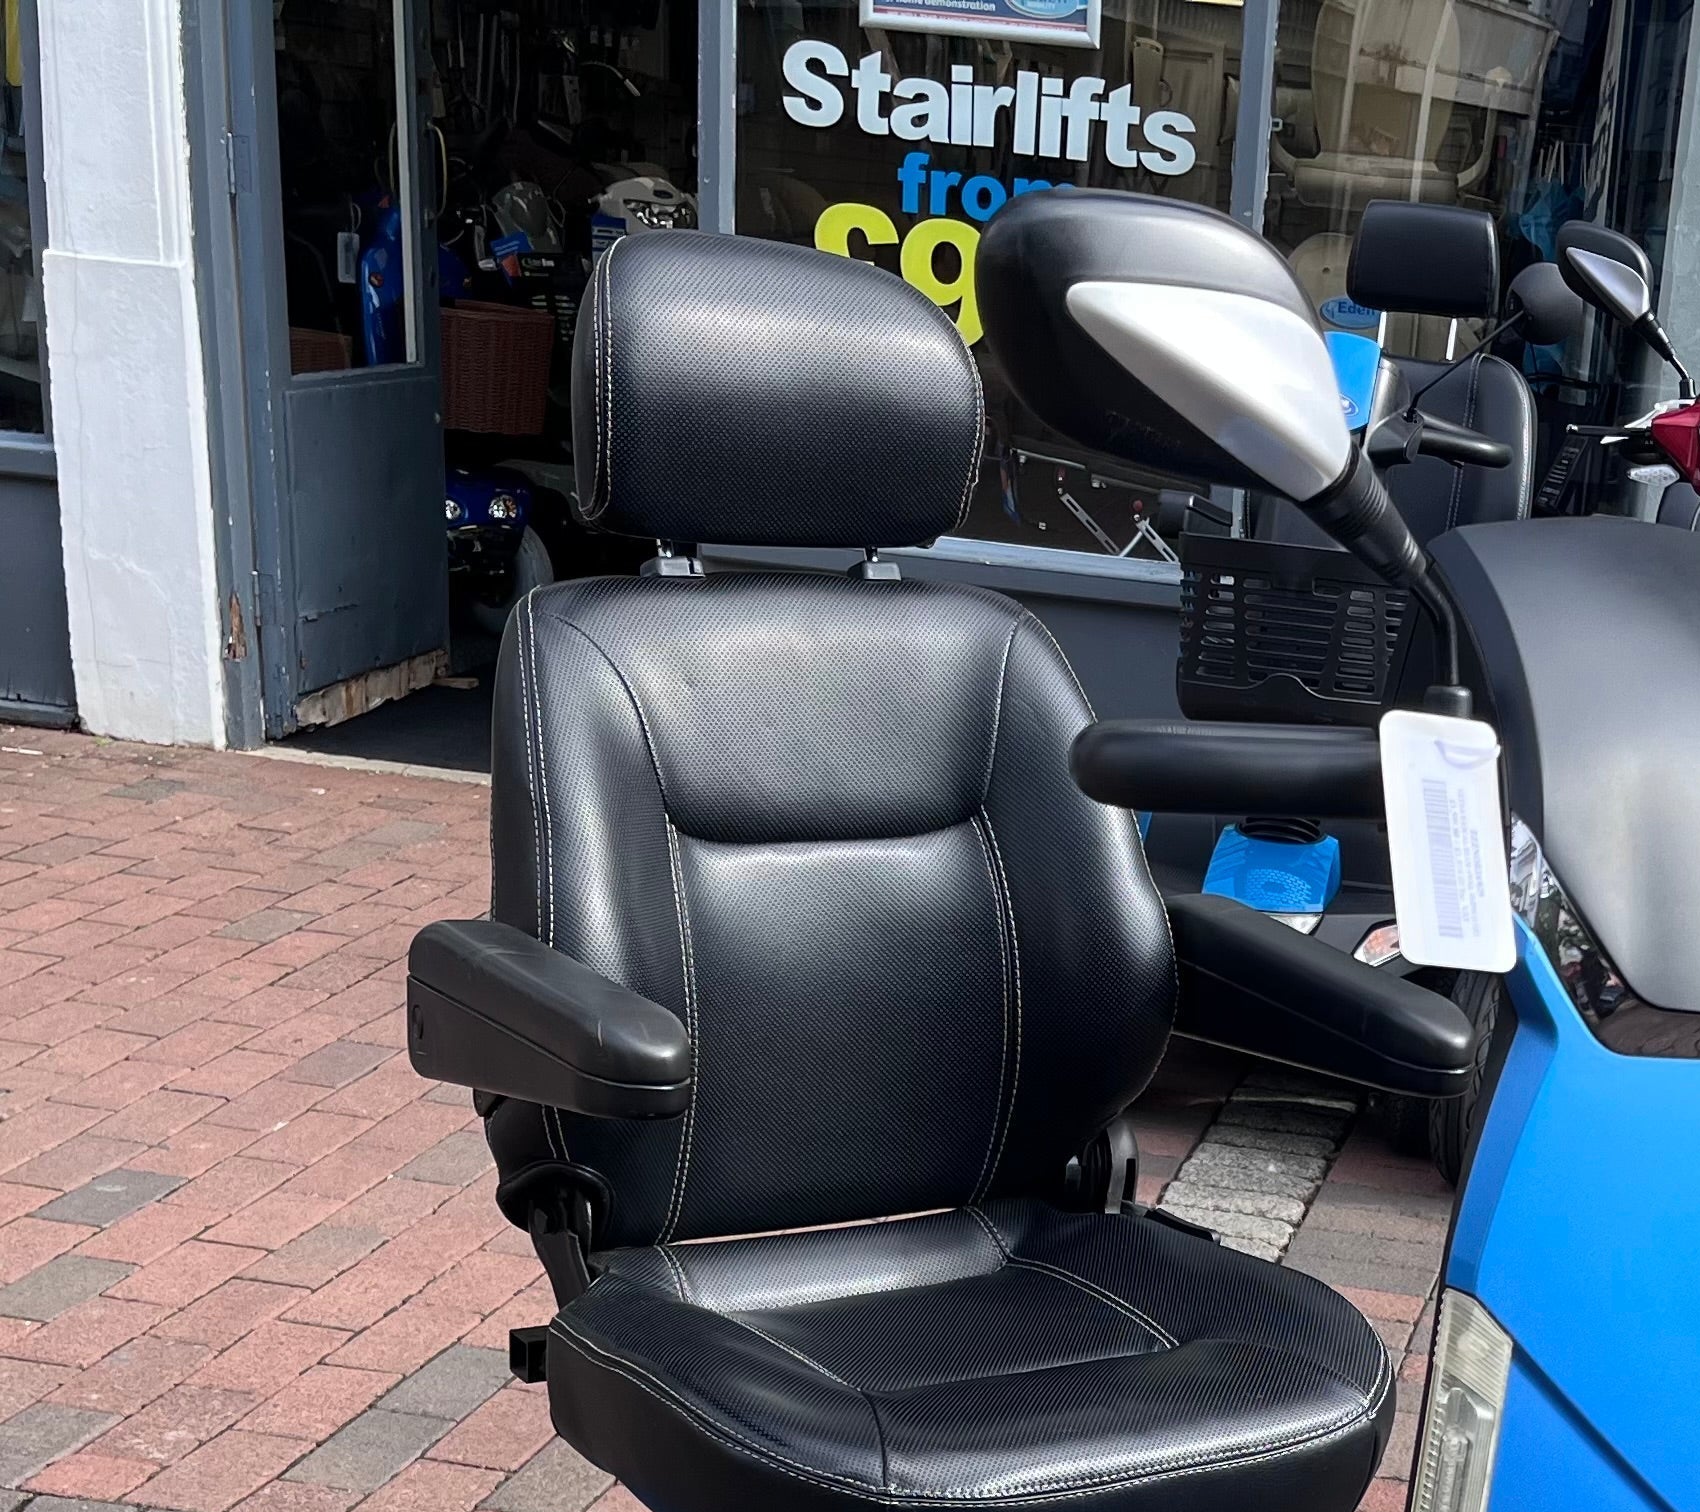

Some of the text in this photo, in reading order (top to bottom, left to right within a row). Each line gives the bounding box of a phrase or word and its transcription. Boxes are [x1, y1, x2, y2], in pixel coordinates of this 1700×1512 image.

[782, 40, 1197, 175] Stairlifts
[897, 151, 1077, 222] fro
[1337, 301, 1376, 316] Eden
